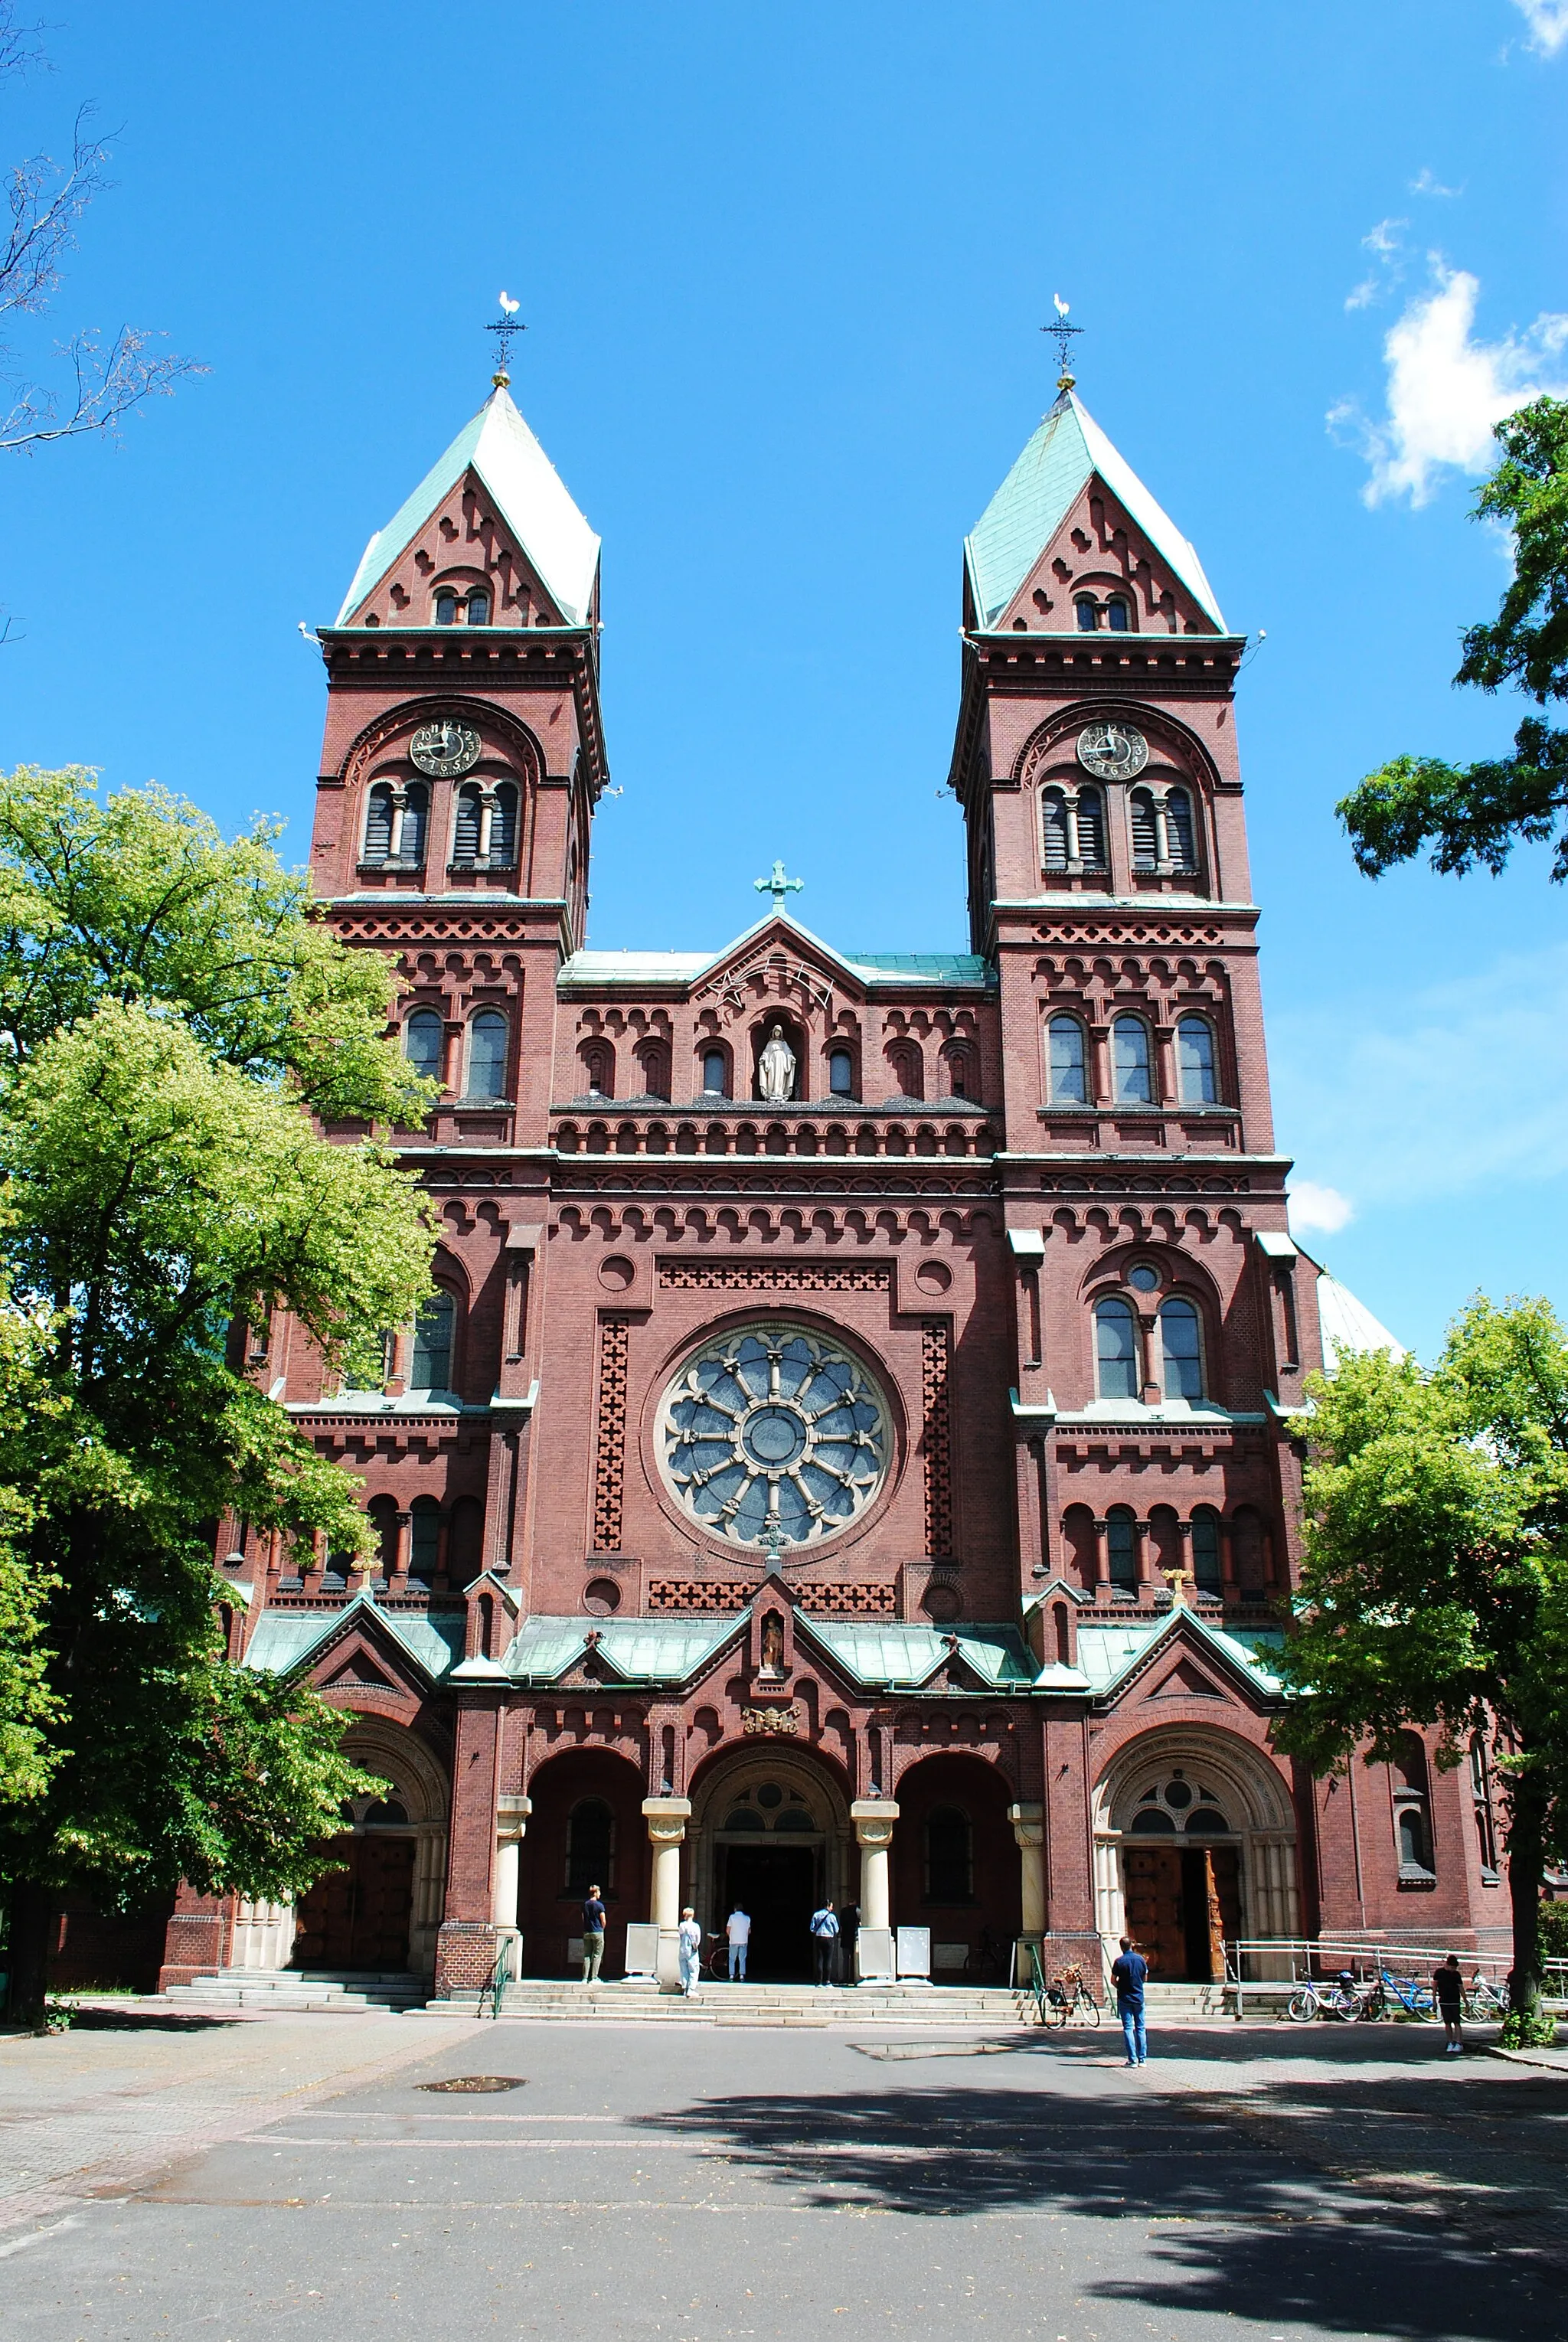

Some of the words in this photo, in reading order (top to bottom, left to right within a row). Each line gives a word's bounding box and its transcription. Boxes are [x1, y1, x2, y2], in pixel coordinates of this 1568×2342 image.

[431, 724, 439, 733] 11
[457, 725, 461, 733] 1
[1096, 727, 1103, 736] 11
[1122, 728, 1126, 737] 1
[421, 731, 431, 741] 10
[465, 730, 472, 740] 2
[1087, 734, 1097, 743] 10
[1130, 735, 1138, 745] 2
[468, 741, 475, 751] 3
[1135, 746, 1142, 756] 3
[462, 752, 469, 761] 4
[1132, 756, 1138, 766] 4
[429, 760, 436, 769] 7
[440, 762, 447, 772] 6
[452, 760, 460, 769] 5
[1099, 763, 1106, 773] 7
[1124, 765, 1130, 773] 5
[1111, 766, 1118, 776] 6
